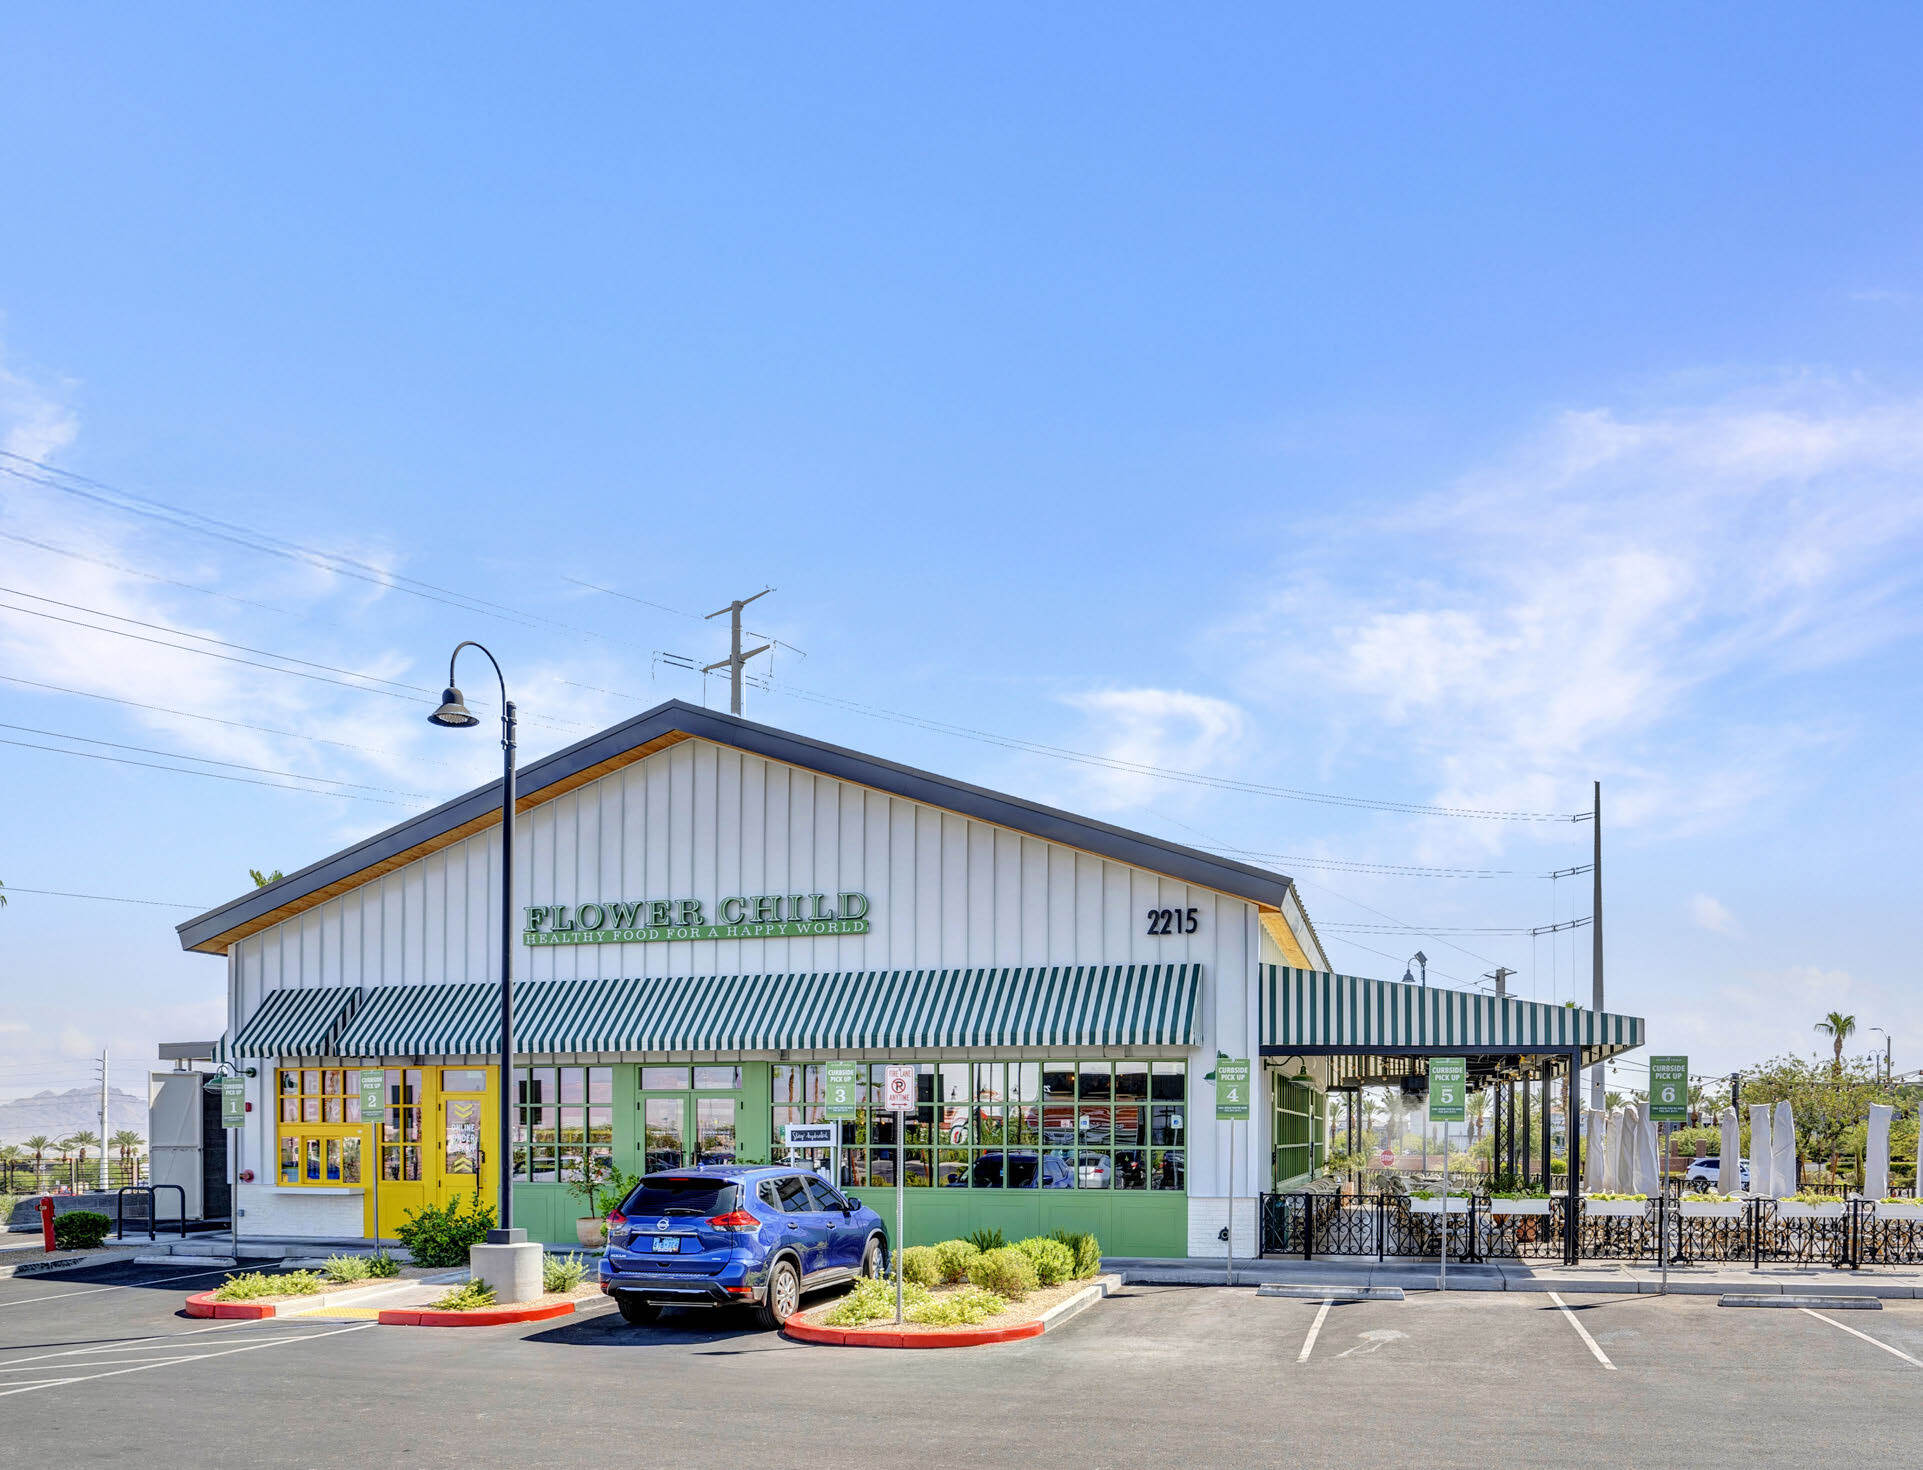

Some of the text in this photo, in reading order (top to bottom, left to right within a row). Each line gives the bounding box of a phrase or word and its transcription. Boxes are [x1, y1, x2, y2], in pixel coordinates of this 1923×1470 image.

[523, 892, 869, 932] FLOWER CHILD
[1147, 908, 1198, 935] 2215
[525, 921, 864, 945] HEALTHY FOOD FOR A HAPPY WORLD
[1652, 1064, 1686, 1072] CURBSIDE
[1655, 1072, 1683, 1080] PICK UP
[368, 1095, 376, 1107] 2
[835, 1089, 846, 1103] 3
[1226, 1088, 1240, 1102] 4
[1440, 1088, 1454, 1104] 5
[1661, 1087, 1676, 1103] 6
[231, 1102, 237, 1113] 1
